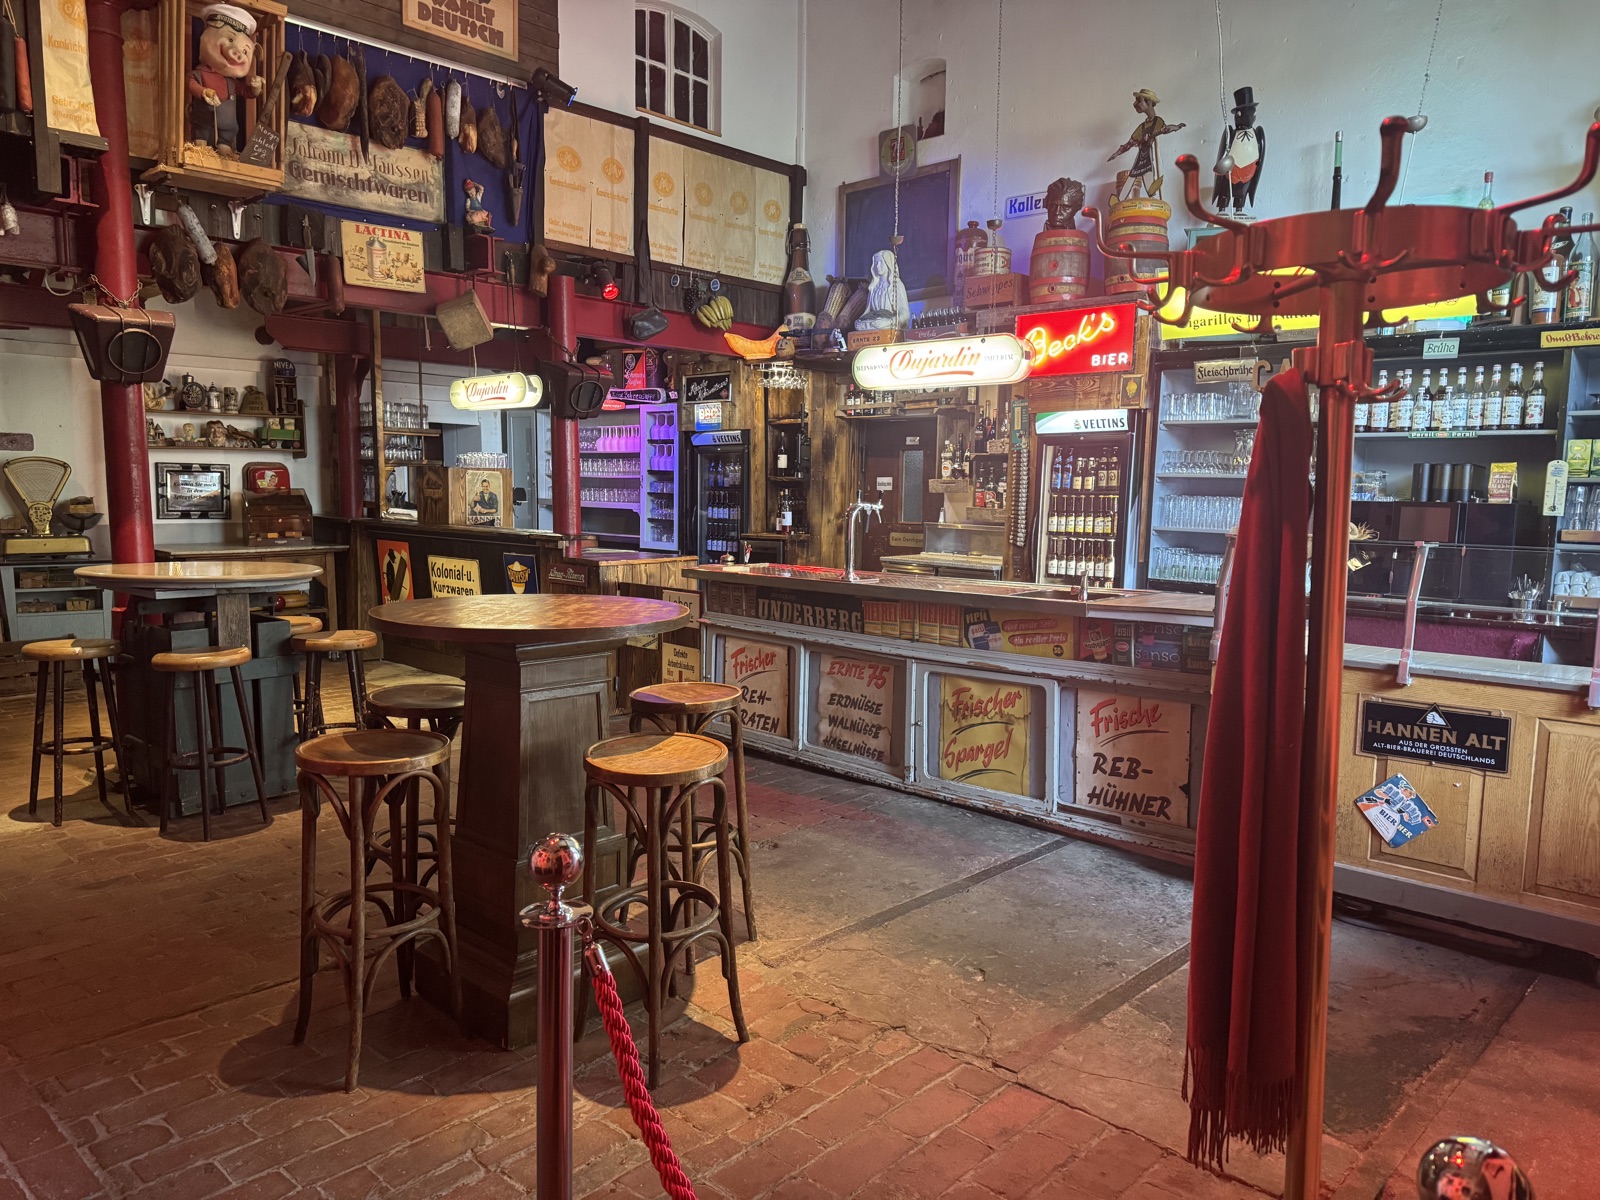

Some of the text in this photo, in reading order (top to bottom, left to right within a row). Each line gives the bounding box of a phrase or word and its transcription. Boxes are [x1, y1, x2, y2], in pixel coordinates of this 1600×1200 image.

[418, 1, 503, 48] DEUTSCH
[288, 137, 345, 166] Johann
[371, 154, 430, 183] Janssen
[288, 160, 428, 203] Gemischtwaren
[355, 224, 411, 241] LACTINA
[1188, 313, 1242, 330] igarillos
[1024, 312, 1115, 366] Beck's
[1425, 342, 1456, 354] Brühe
[274, 361, 294, 370] NIVEA
[889, 346, 981, 378] Dujardin
[1091, 352, 1129, 366] BIER
[1197, 363, 1253, 380] Fleischbrühe
[465, 380, 509, 402] Dujardin
[1083, 418, 1126, 430] VELTINS
[716, 435, 741, 443] VELTINS
[430, 561, 475, 582] Kolonial-u.
[433, 581, 474, 596] Kurzwaren
[758, 598, 863, 634] UNDERBERG
[1114, 625, 1132, 637] Persil
[731, 647, 777, 679] Frischer
[1135, 650, 1180, 663] sanso
[827, 660, 891, 690] ERNTE 75
[741, 686, 772, 705] REH-
[827, 692, 884, 716] ERDNÜSSE
[951, 686, 1023, 722] Frischer
[740, 709, 780, 733] RATEN
[828, 714, 883, 739] WALNÜSSE
[1089, 696, 1163, 738] Frische
[1367, 719, 1506, 751] HANNEN ALT
[1399, 739, 1468, 755] AUS DER GRÖSSTEN
[822, 735, 885, 762] HASELNÜSSE
[943, 727, 1015, 773] Spargel
[1373, 741, 1496, 765] ALT-BIER-BRAUEREI DEUTSCHLANDS
[1092, 752, 1154, 780] REB-
[1087, 782, 1172, 821] HÜHNER
[1379, 808, 1398, 826] BIER
